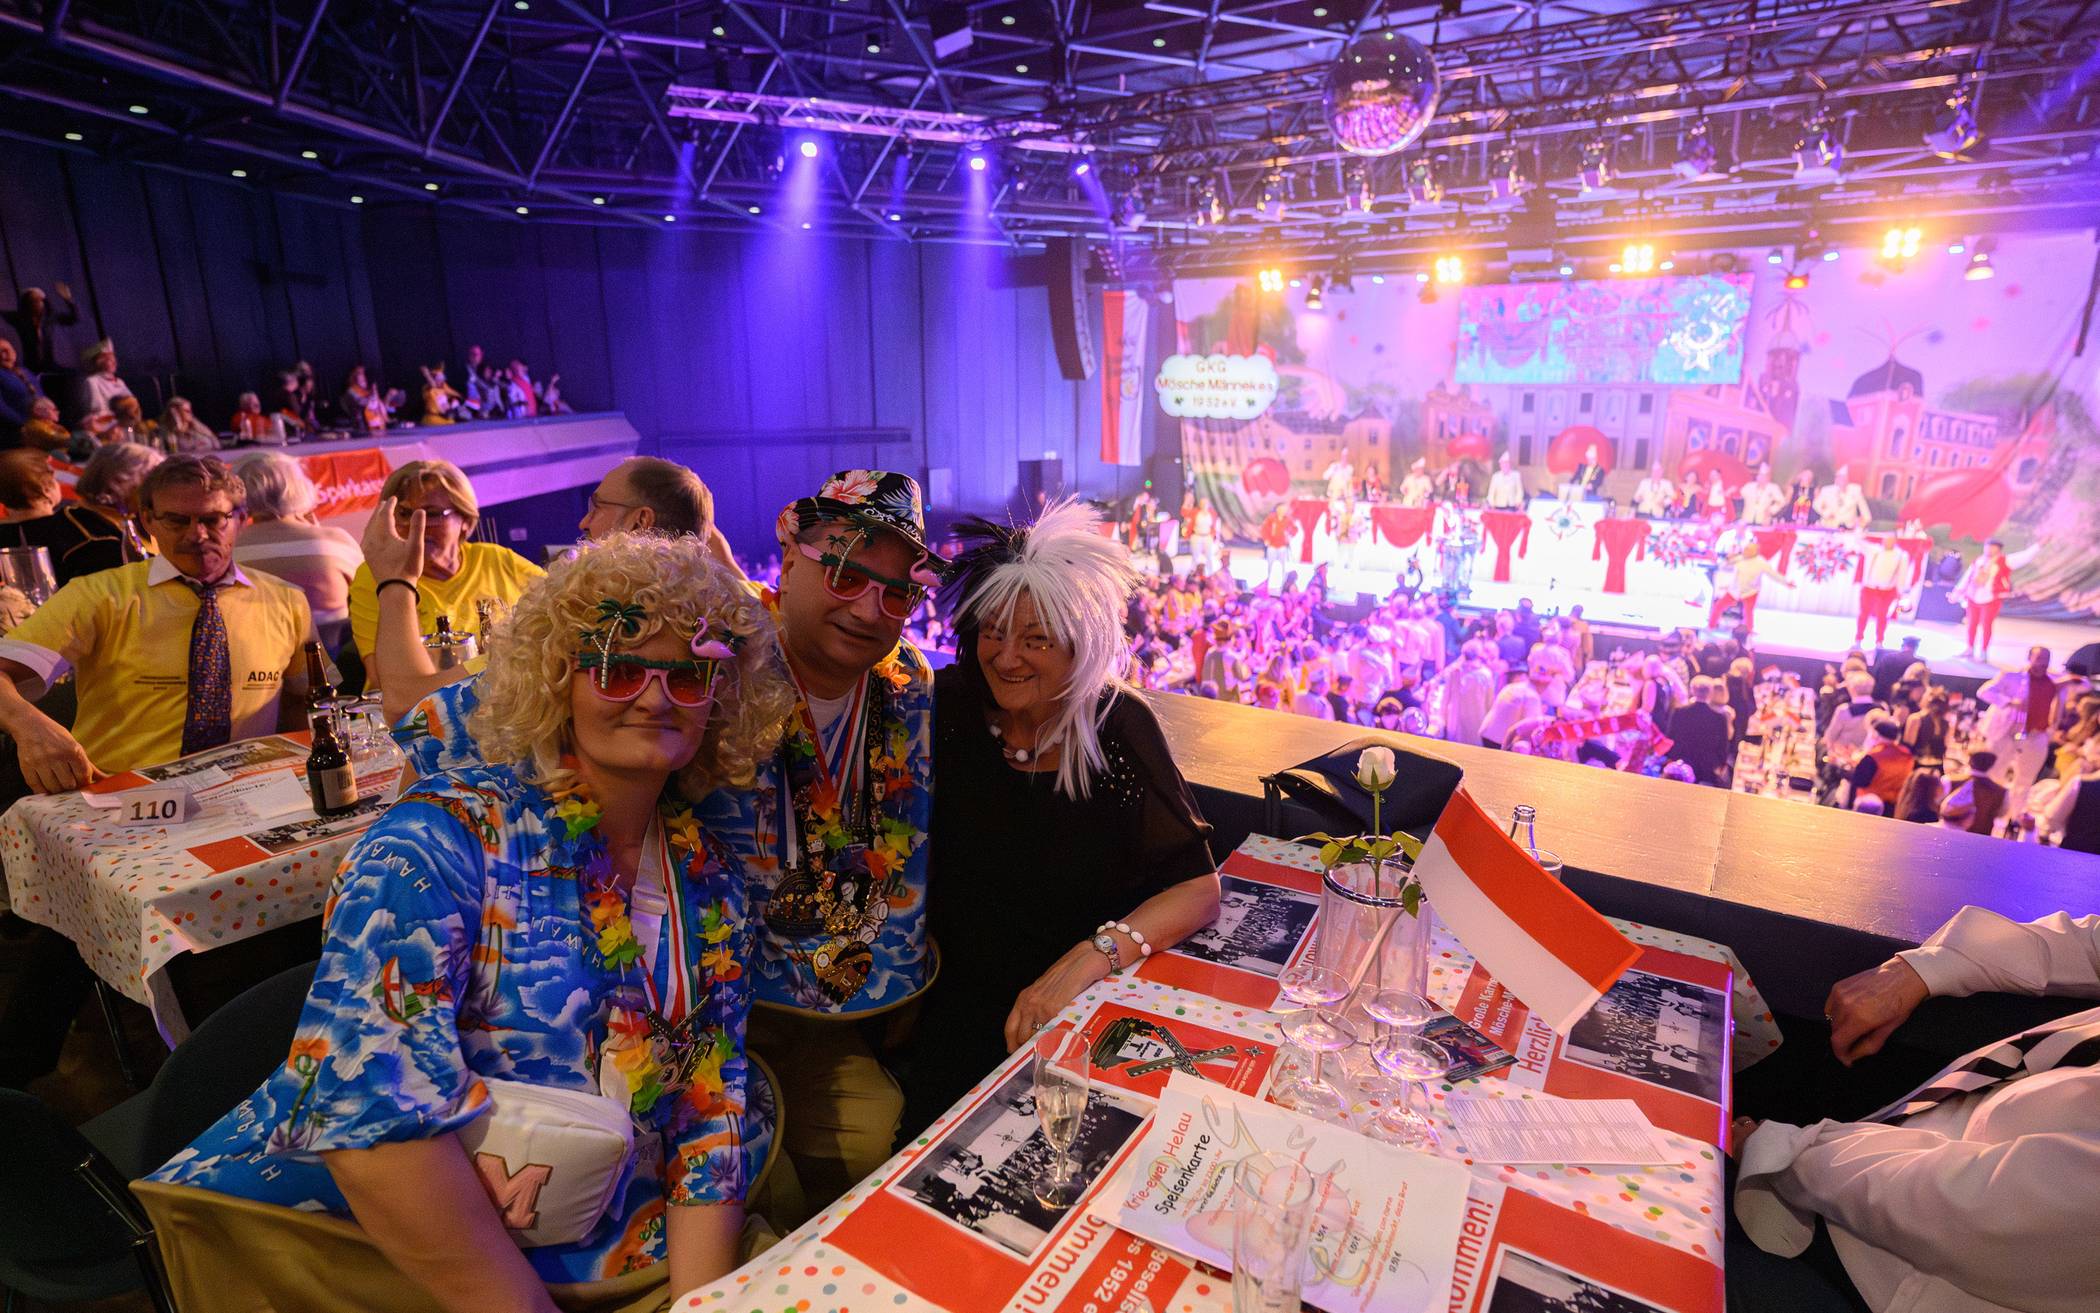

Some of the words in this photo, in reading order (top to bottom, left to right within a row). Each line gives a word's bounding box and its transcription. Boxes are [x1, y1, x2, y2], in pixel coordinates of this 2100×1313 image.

[130, 799, 177, 821] 110
[1163, 1112, 1194, 1158] Helau
[474, 1152, 553, 1230] M
[1155, 1134, 1211, 1215] Speisenkarte
[1093, 1259, 1134, 1303] 1952
